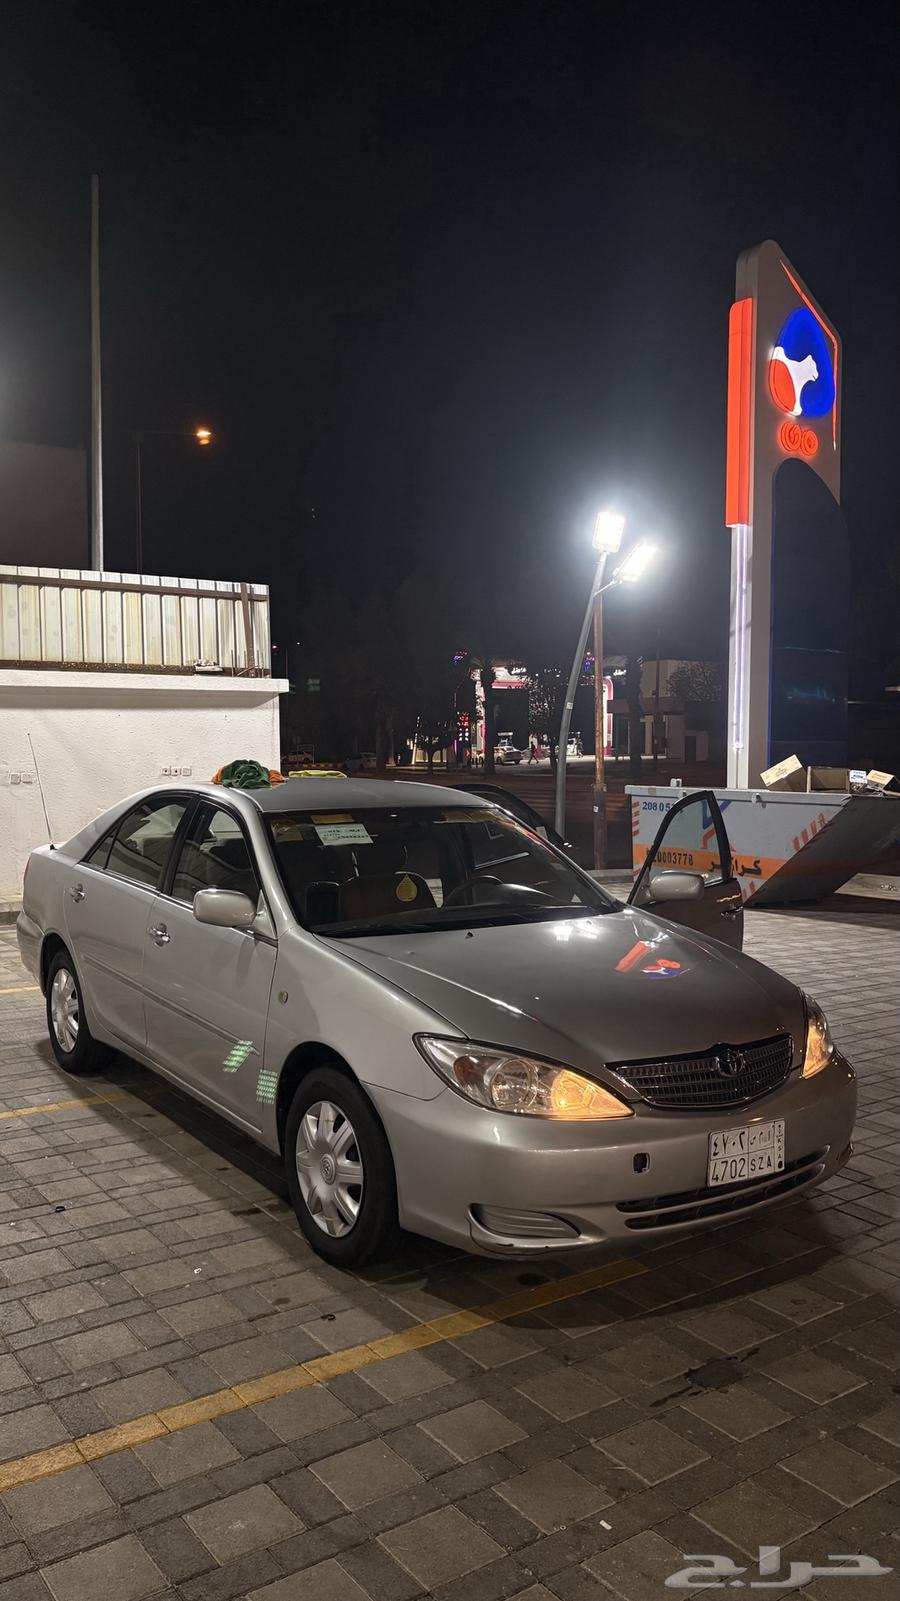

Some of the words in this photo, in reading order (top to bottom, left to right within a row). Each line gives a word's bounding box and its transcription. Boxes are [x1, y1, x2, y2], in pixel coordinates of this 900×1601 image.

[646, 848, 694, 866] 0003778
[711, 1157, 746, 1183] 4702
[750, 1155, 772, 1172] SZA
